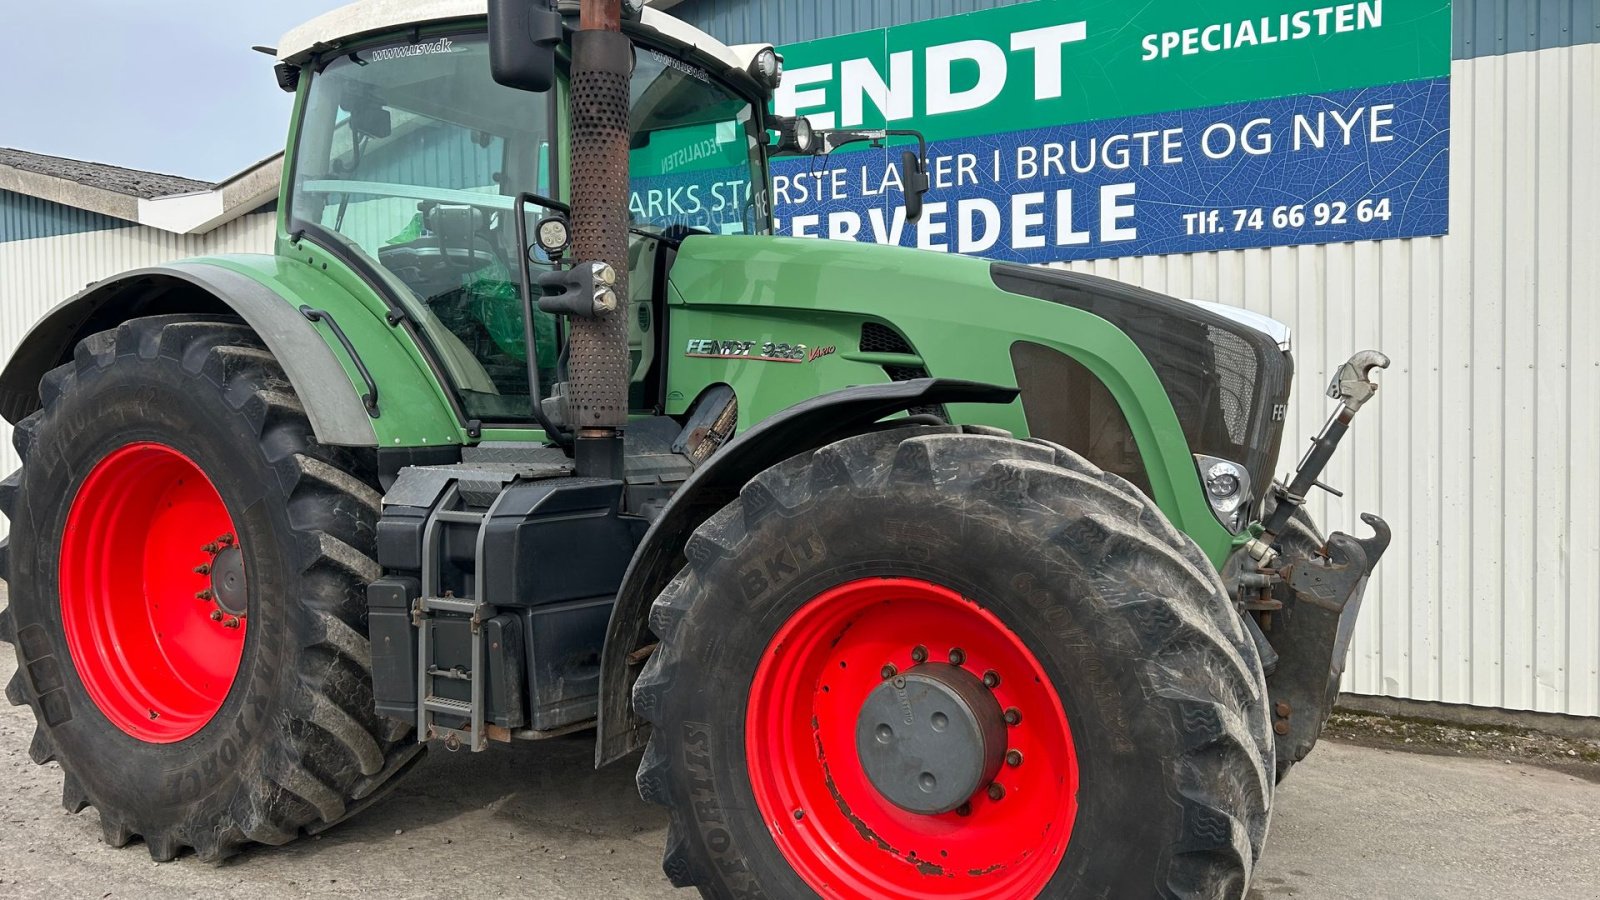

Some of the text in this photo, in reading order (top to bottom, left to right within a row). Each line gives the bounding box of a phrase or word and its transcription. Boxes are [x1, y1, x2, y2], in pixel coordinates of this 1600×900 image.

[373, 38, 453, 61] www.usv.dk
[1141, 0, 1383, 61] SPECIALISTEN
[774, 21, 1087, 136] ENDT
[994, 150, 1000, 182] I
[1017, 128, 1183, 179] BRUGTE
[1201, 118, 1272, 159] OG
[1294, 104, 1395, 151] NYE
[775, 182, 1137, 254] ERVEDELE
[1183, 198, 1392, 235] Tlf. 74 66 92 64
[686, 339, 756, 356] FENDT
[740, 534, 815, 602] BKT
